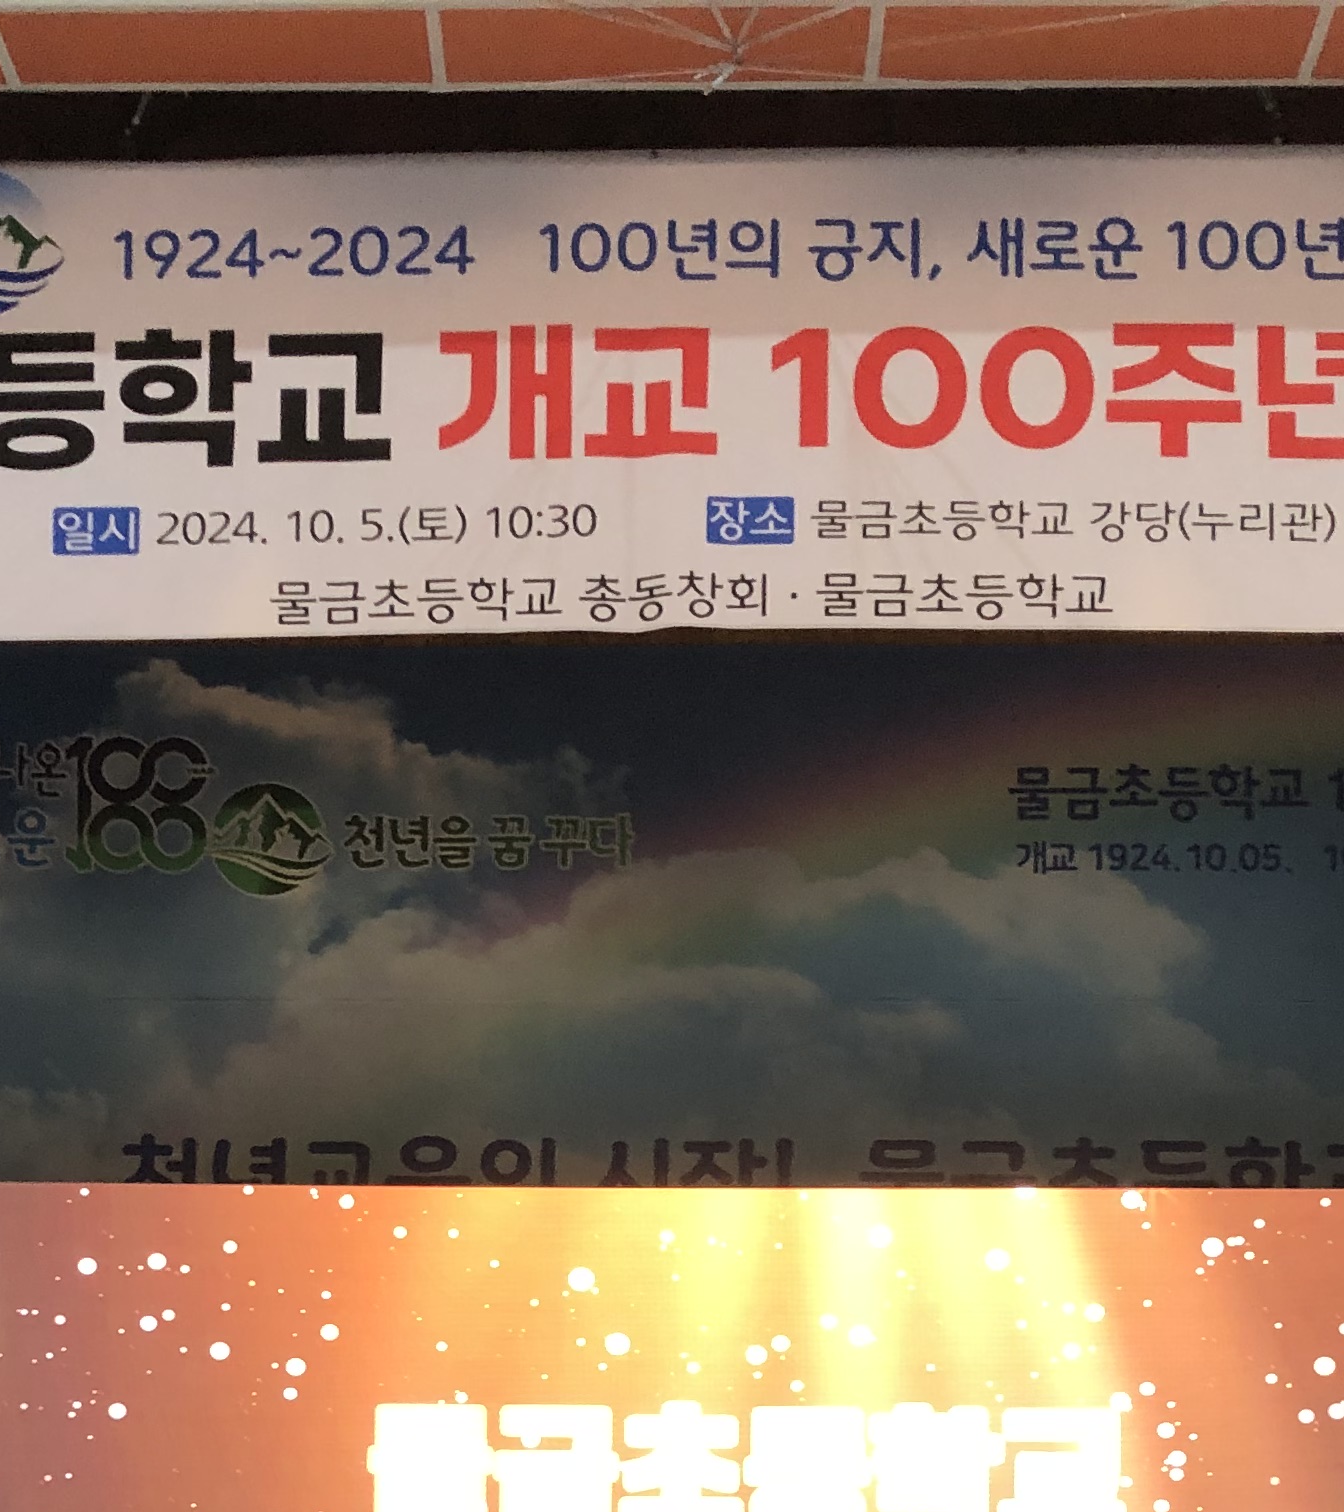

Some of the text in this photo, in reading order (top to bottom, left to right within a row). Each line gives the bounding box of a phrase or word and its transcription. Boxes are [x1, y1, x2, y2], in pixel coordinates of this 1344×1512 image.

[113, 223, 475, 280] 1924~2024
[540, 217, 780, 282] 100년의
[808, 217, 943, 284] 긍지,
[967, 215, 1143, 283] 새로운
[437, 322, 719, 461] 개교
[56, 503, 598, 553] 일시 2024. 10. 5.(토) 10:30
[709, 498, 1337, 544] 장소 물금초등학교 강당(누리관)
[270, 570, 1115, 626] 물금초등학교 총동창회 물금초등학교
[1007, 763, 1312, 823] 물금초등학교
[341, 812, 473, 870] 천년을
[1015, 840, 1079, 876] 개교
